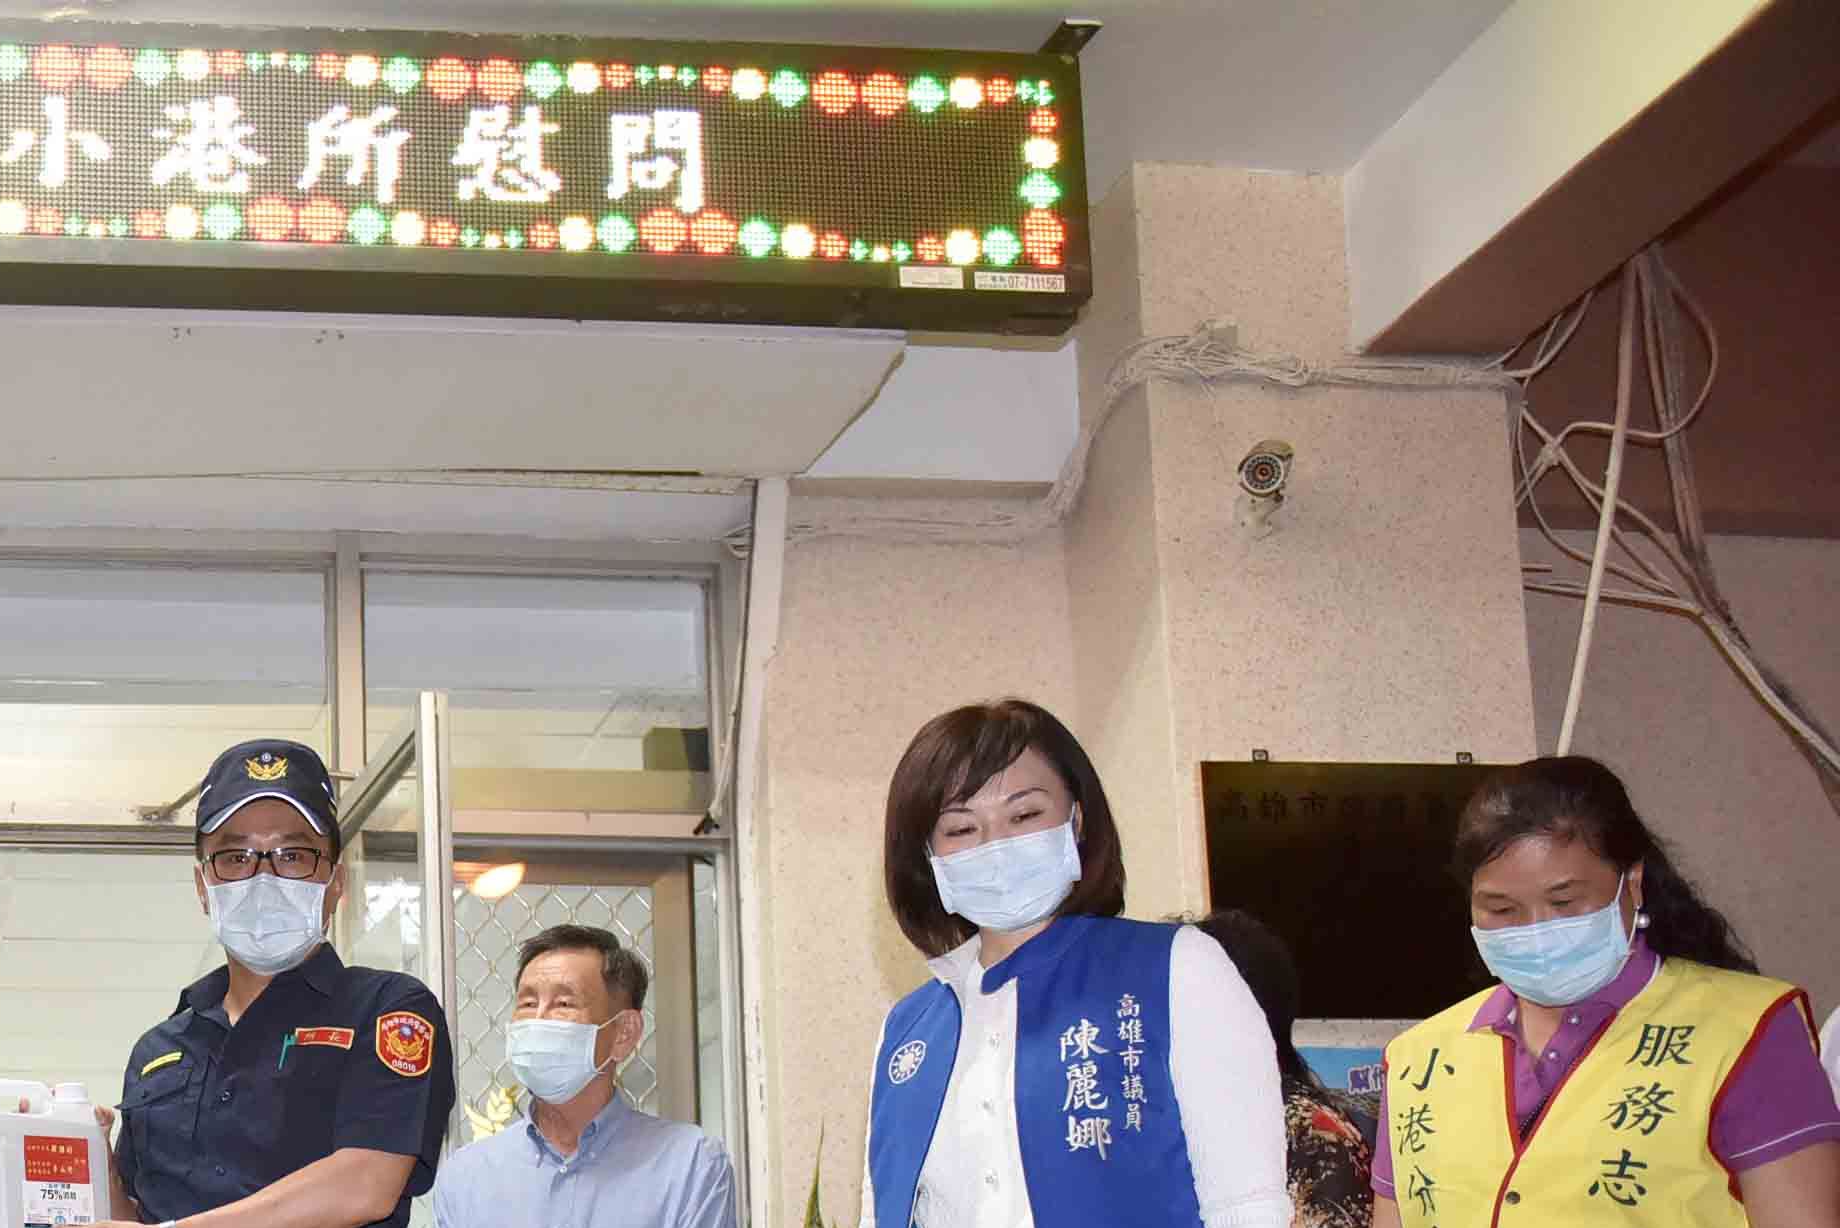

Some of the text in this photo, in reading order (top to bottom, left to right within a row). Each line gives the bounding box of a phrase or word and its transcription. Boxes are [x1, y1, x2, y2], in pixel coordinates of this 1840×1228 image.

[1058, 1018, 1112, 1161] 陳麗娜
[1116, 993, 1148, 1133] 高雄市議員
